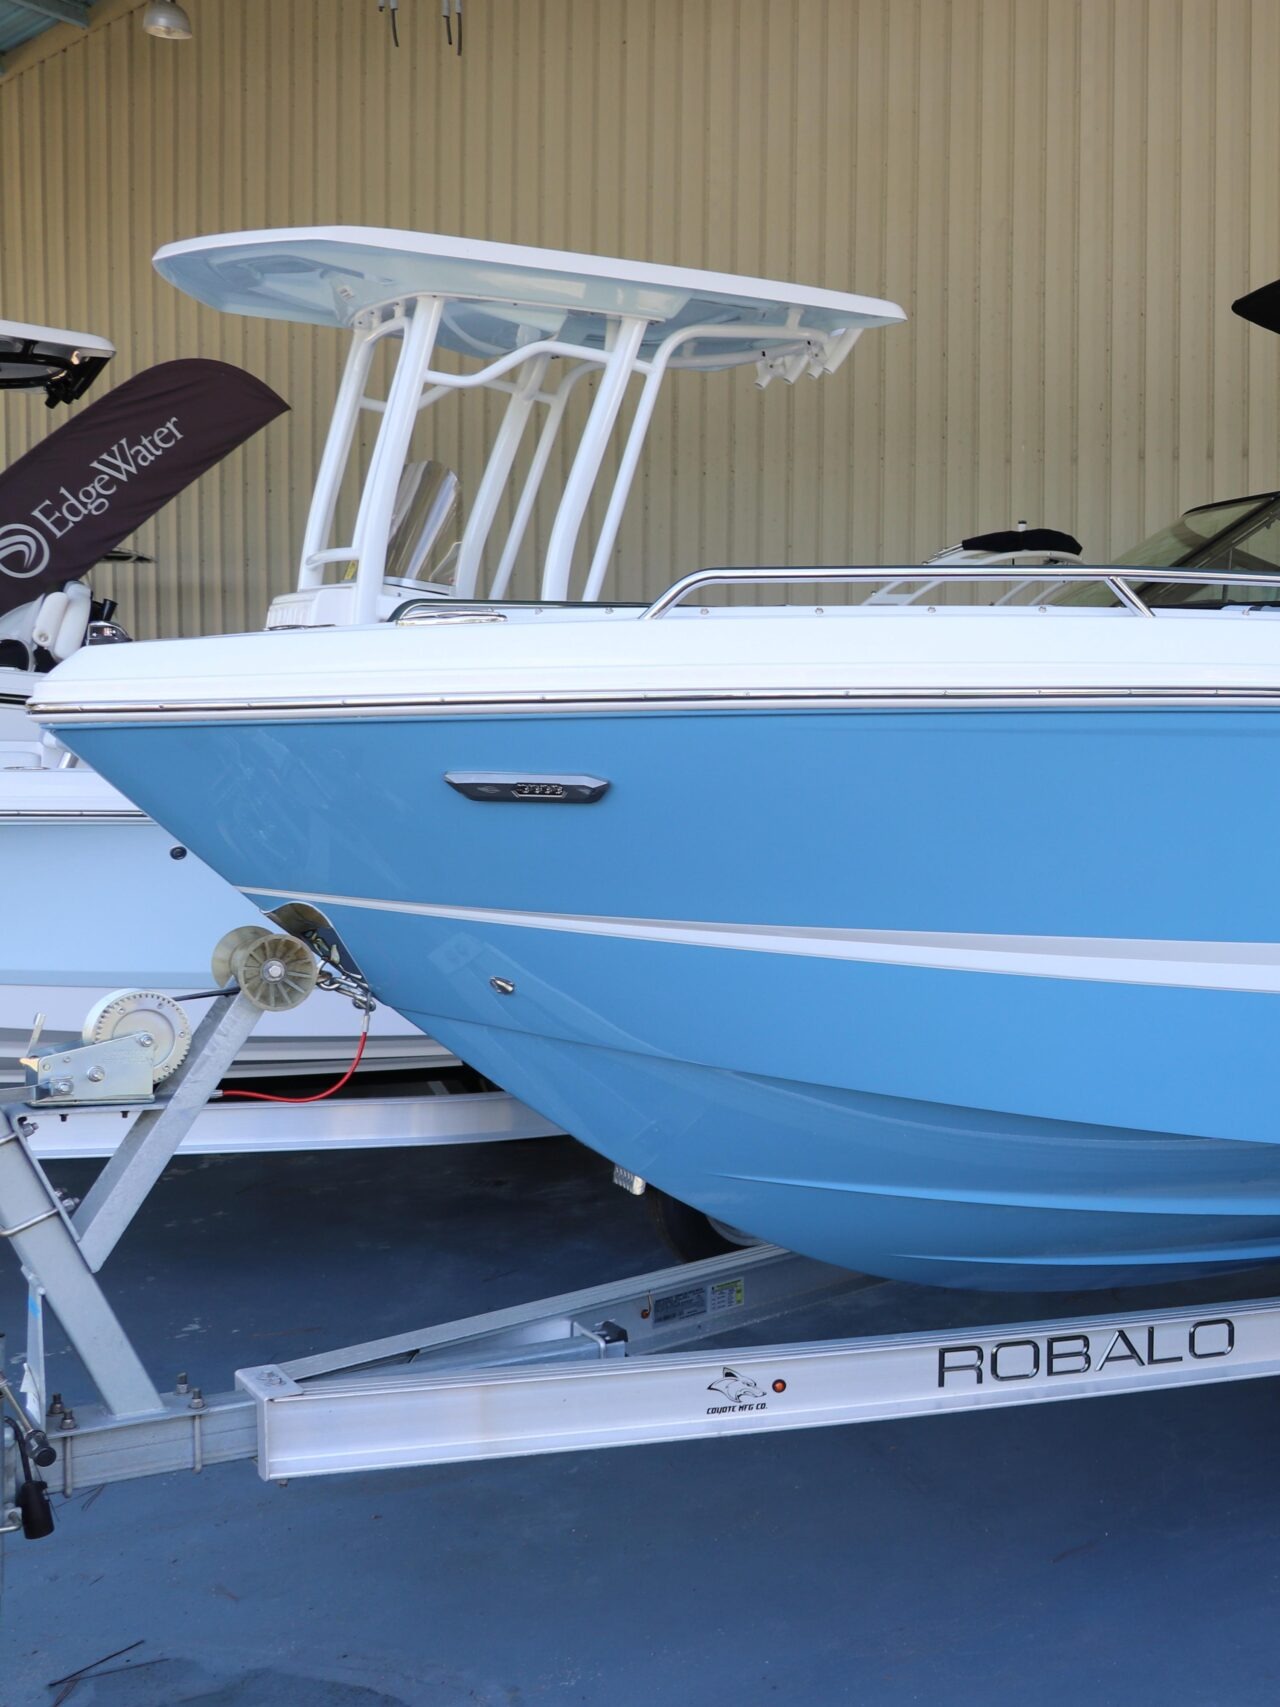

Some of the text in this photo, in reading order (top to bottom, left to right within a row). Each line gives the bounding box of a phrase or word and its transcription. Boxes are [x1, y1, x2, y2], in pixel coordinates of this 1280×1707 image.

[31, 416, 185, 539] EdgeWater
[938, 1318, 1235, 1388] ROBALO
[706, 1405, 737, 1415] COYOTE
[738, 1403, 755, 1412] MFG
